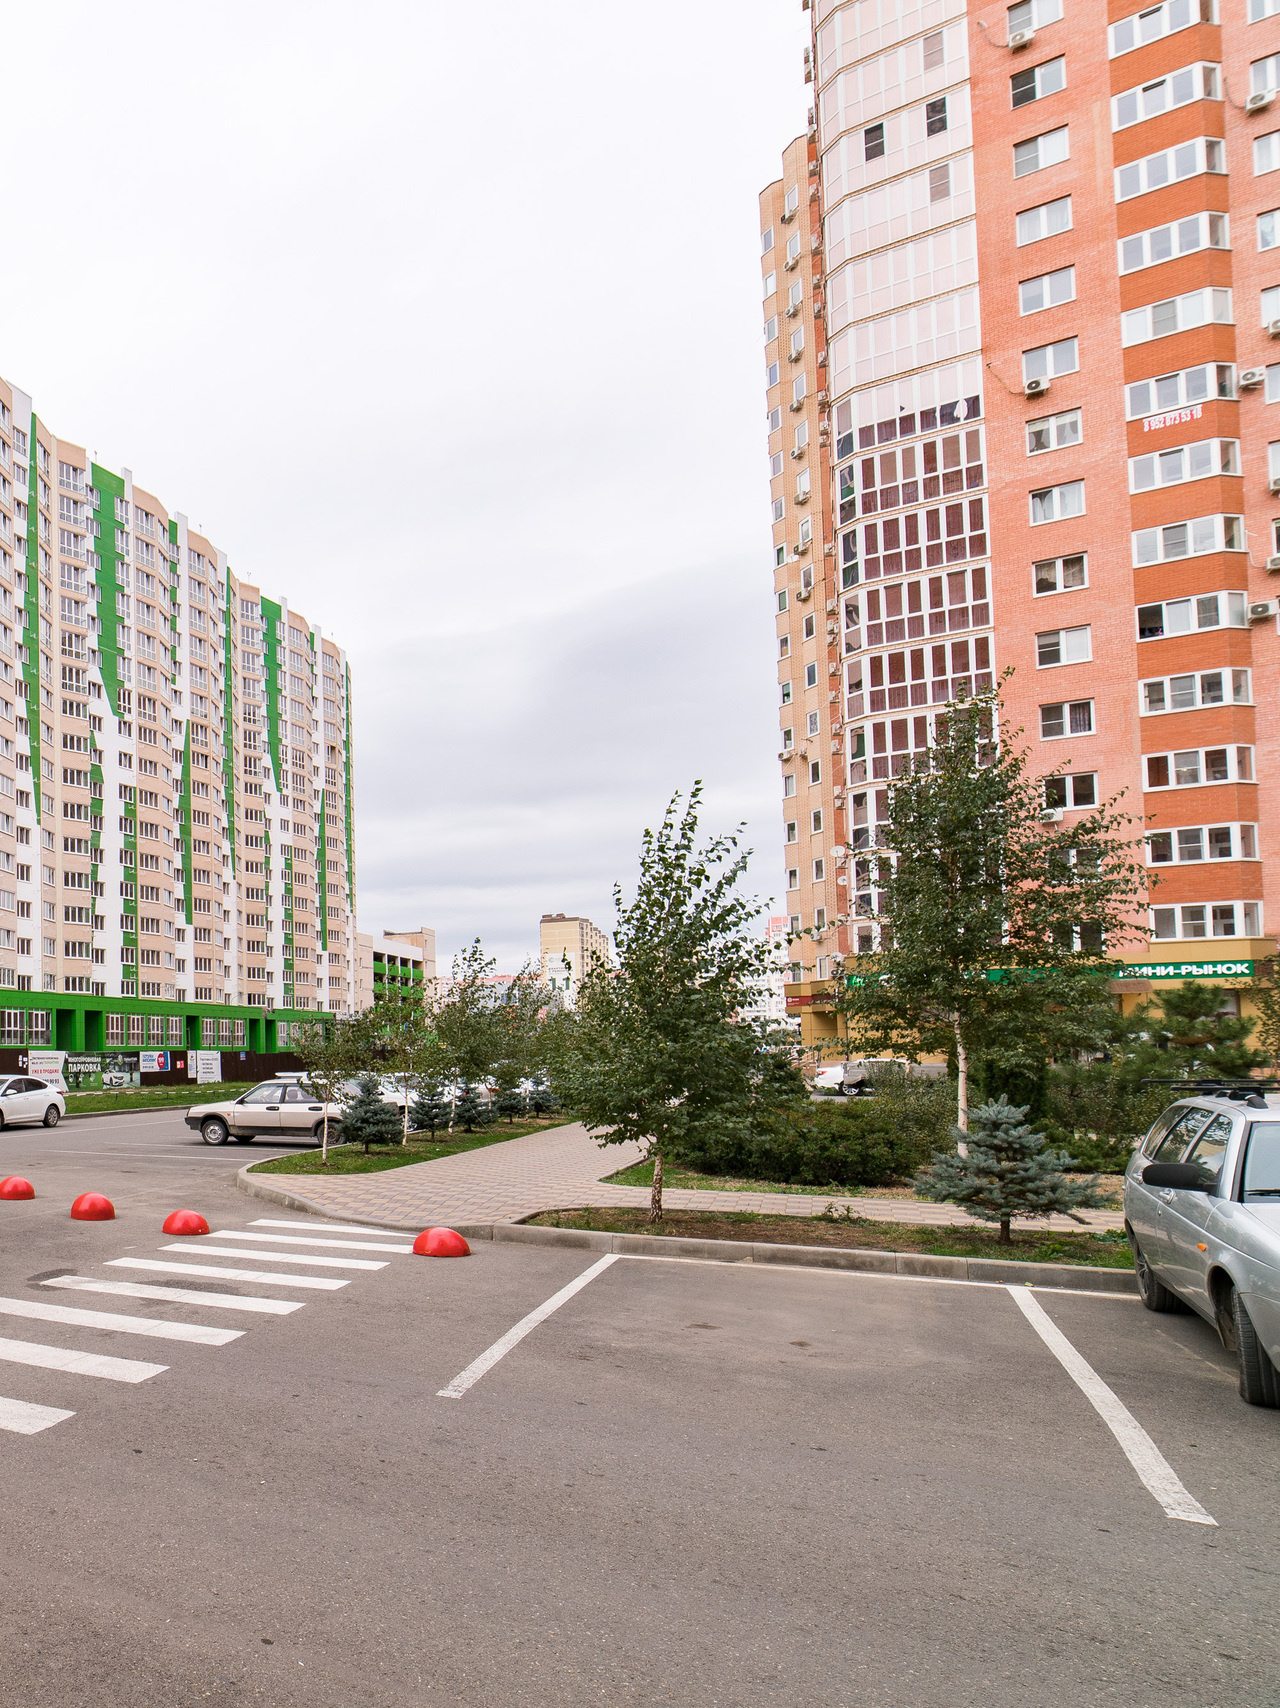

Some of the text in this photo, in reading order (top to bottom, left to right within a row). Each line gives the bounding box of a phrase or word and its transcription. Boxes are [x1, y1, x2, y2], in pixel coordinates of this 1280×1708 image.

[1143, 420, 1150, 432] 8
[1150, 417, 1165, 430] 952
[68, 1063, 102, 1073] ПАРКОВКА
